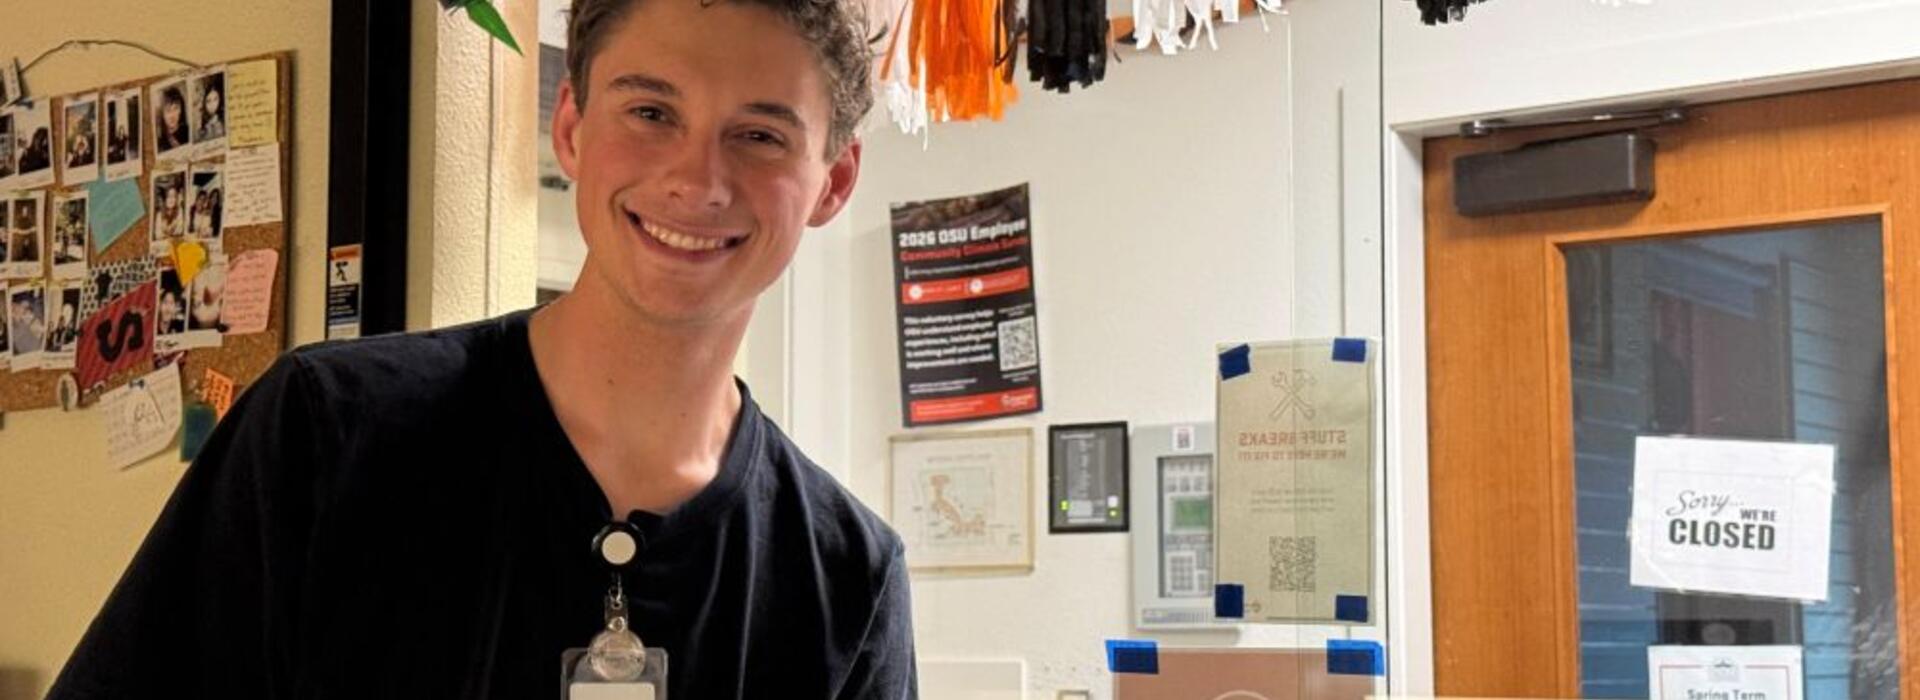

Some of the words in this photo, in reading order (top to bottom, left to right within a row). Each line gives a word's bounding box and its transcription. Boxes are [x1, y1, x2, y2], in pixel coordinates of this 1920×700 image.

[939, 227, 968, 244] OSU
[1740, 508, 1776, 521] WE'RE
[1669, 518, 1775, 550] CLOSED
[1687, 688, 1729, 700] Spring
[1733, 688, 1766, 700] Term
